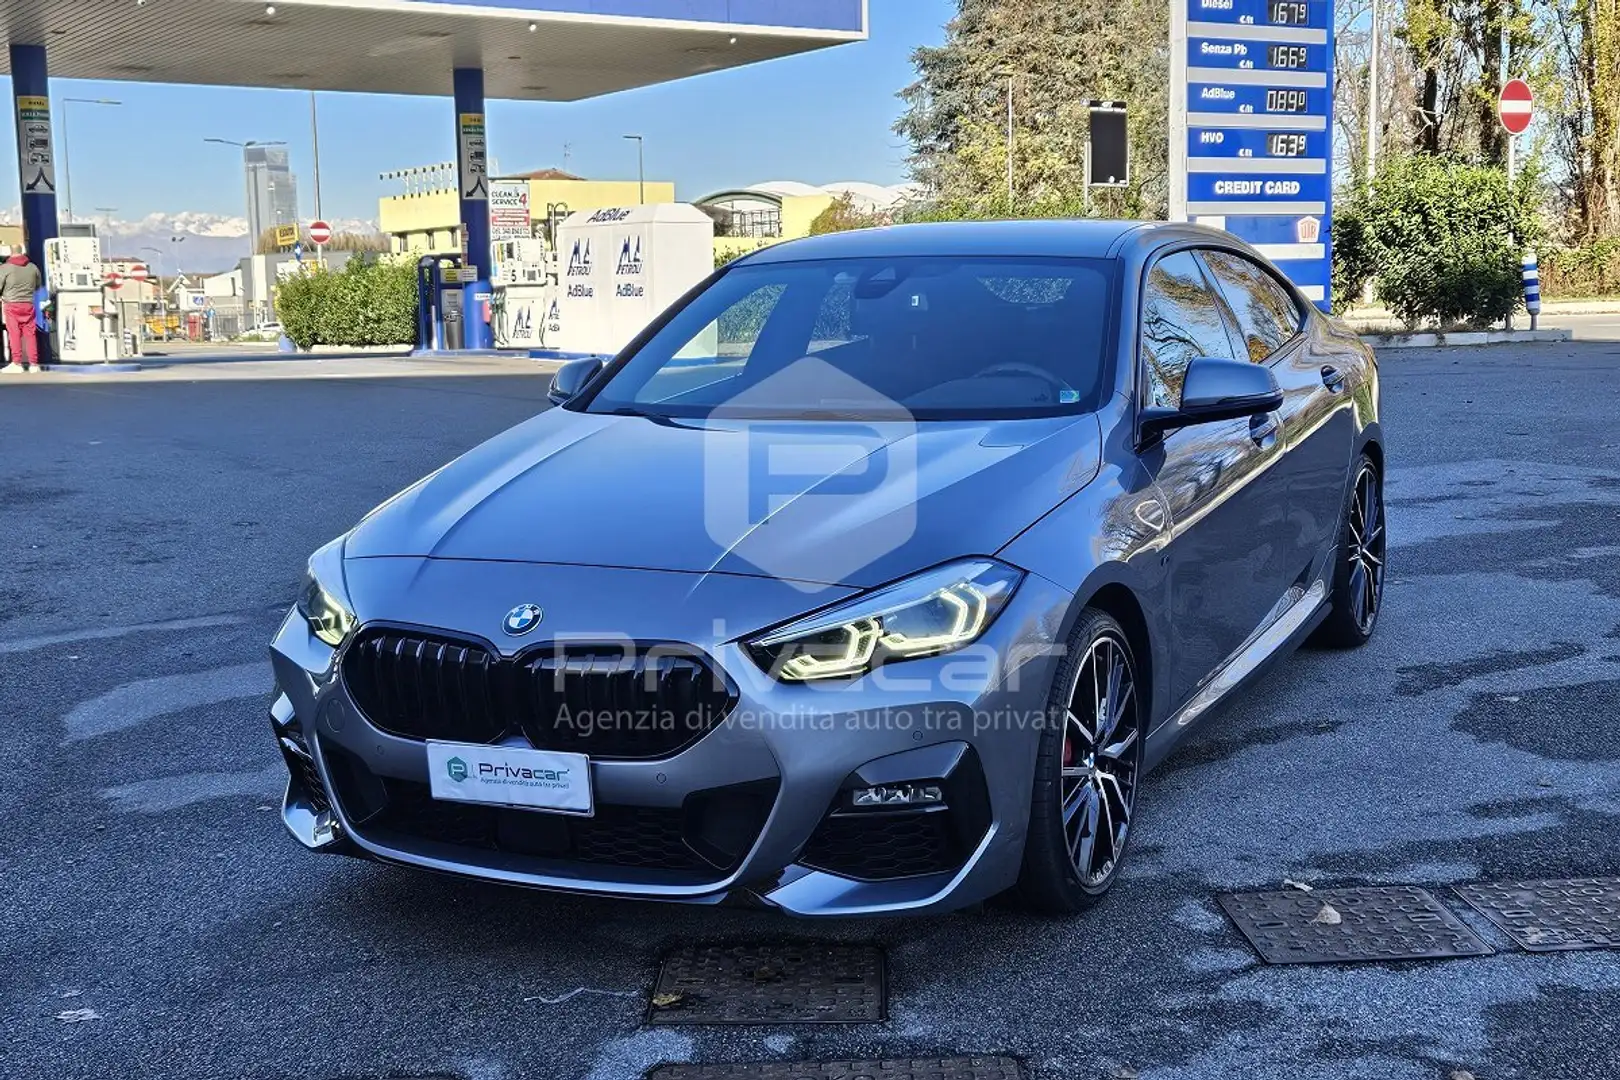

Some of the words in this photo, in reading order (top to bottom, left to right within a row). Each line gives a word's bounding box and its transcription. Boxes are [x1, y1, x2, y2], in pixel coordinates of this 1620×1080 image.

[1201, 42, 1232, 54] Senza
[1234, 44, 1247, 55] Pb
[1202, 87, 1235, 99] AdBlue
[1201, 132, 1224, 143] HVO
[1215, 181, 1262, 194] CREDIT
[1265, 181, 1300, 194] CARD
[586, 208, 630, 223] AdBlue
[511, 269, 517, 282] 5
[567, 283, 593, 297] AdBlue
[616, 283, 644, 297] AdBlue
[478, 762, 569, 781] Privacar
